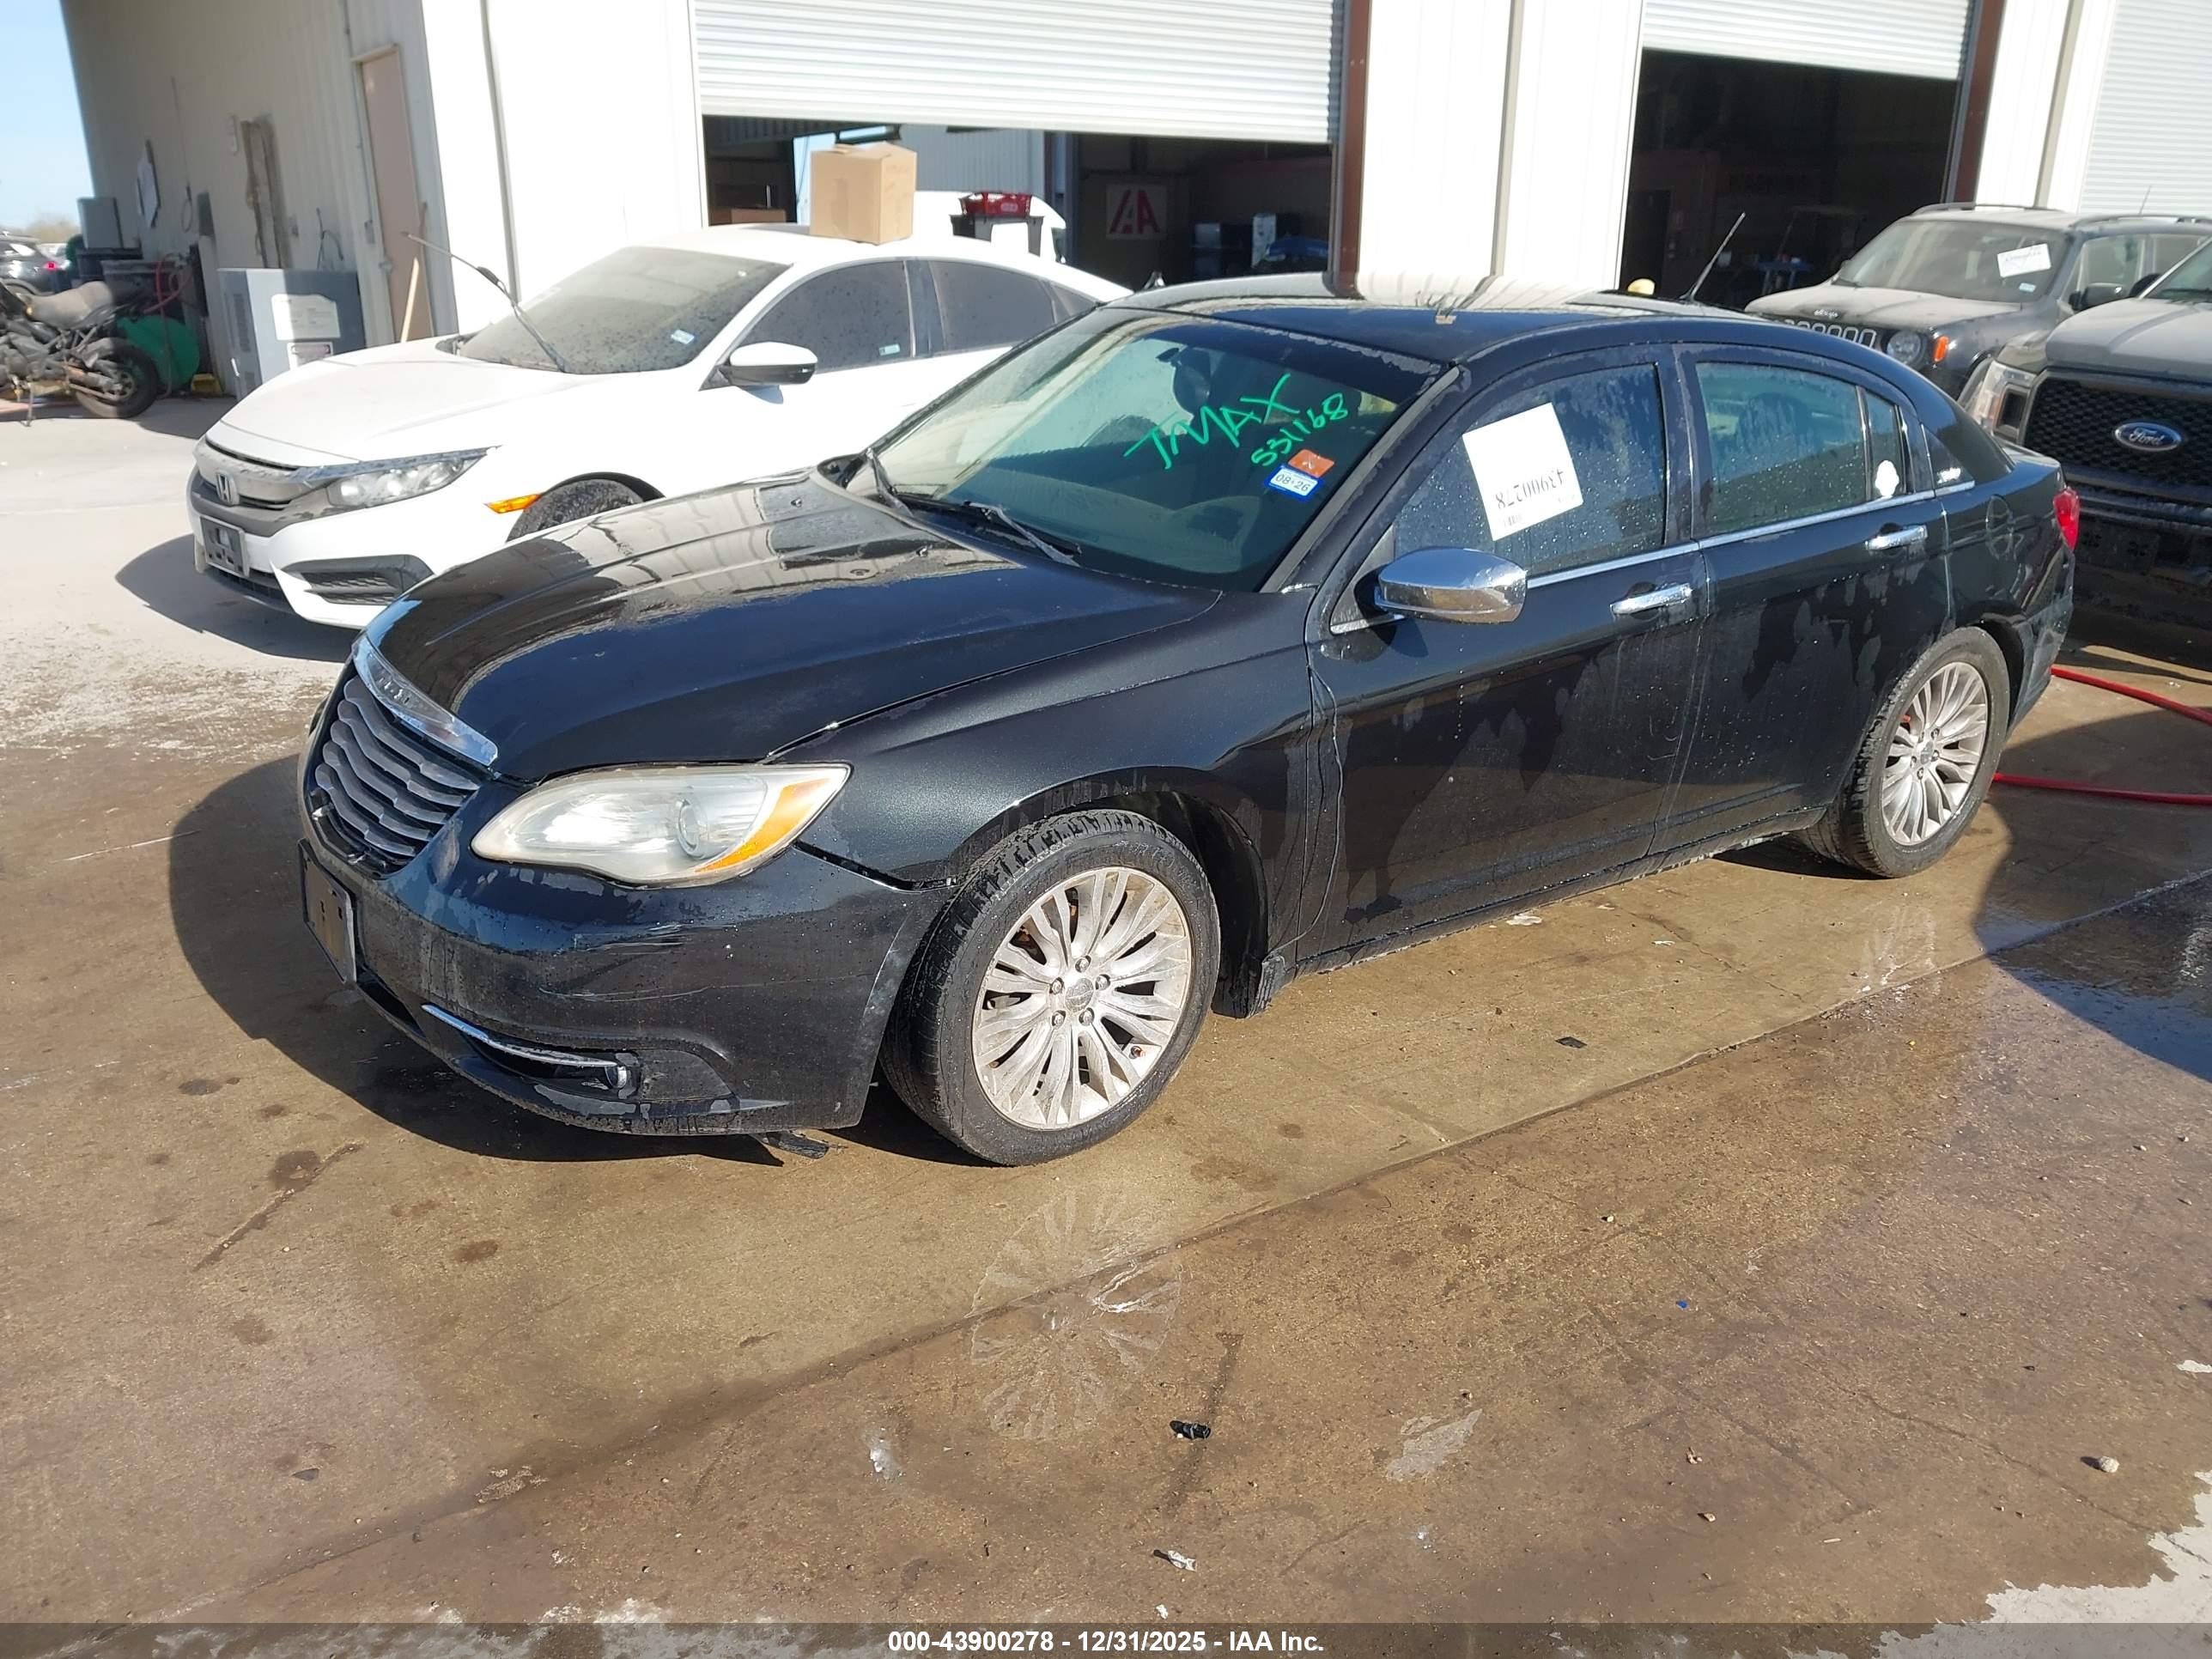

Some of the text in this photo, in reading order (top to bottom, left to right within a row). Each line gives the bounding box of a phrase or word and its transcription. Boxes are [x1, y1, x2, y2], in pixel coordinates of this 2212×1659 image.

[1250, 392, 1348, 466] 531168
[1275, 474, 1311, 492] 08 26
